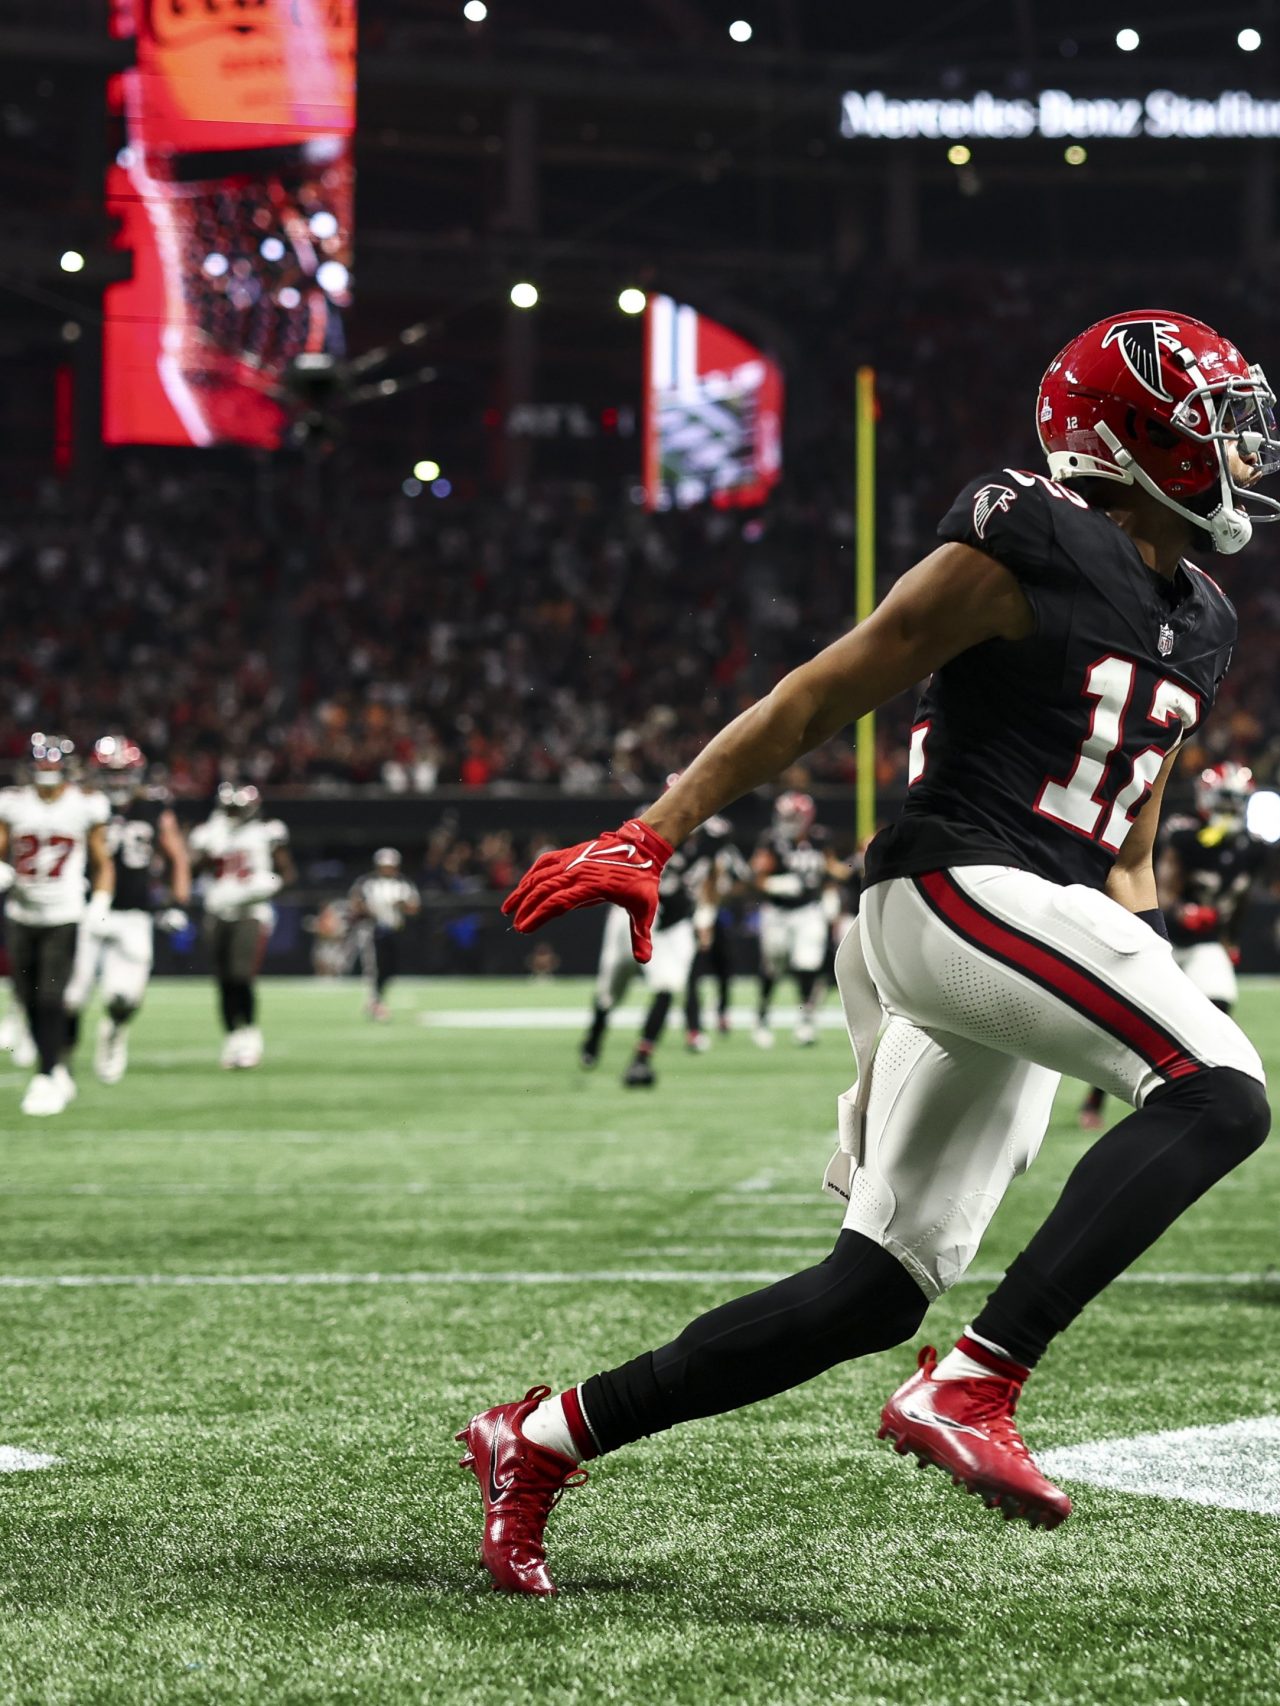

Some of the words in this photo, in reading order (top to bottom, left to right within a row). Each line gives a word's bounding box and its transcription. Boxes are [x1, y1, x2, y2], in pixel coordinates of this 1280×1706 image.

[841, 90, 1142, 138] Mercedes-Benz
[1066, 416, 1078, 430] 12
[1033, 652, 1200, 856] 12
[13, 834, 76, 879] 27
